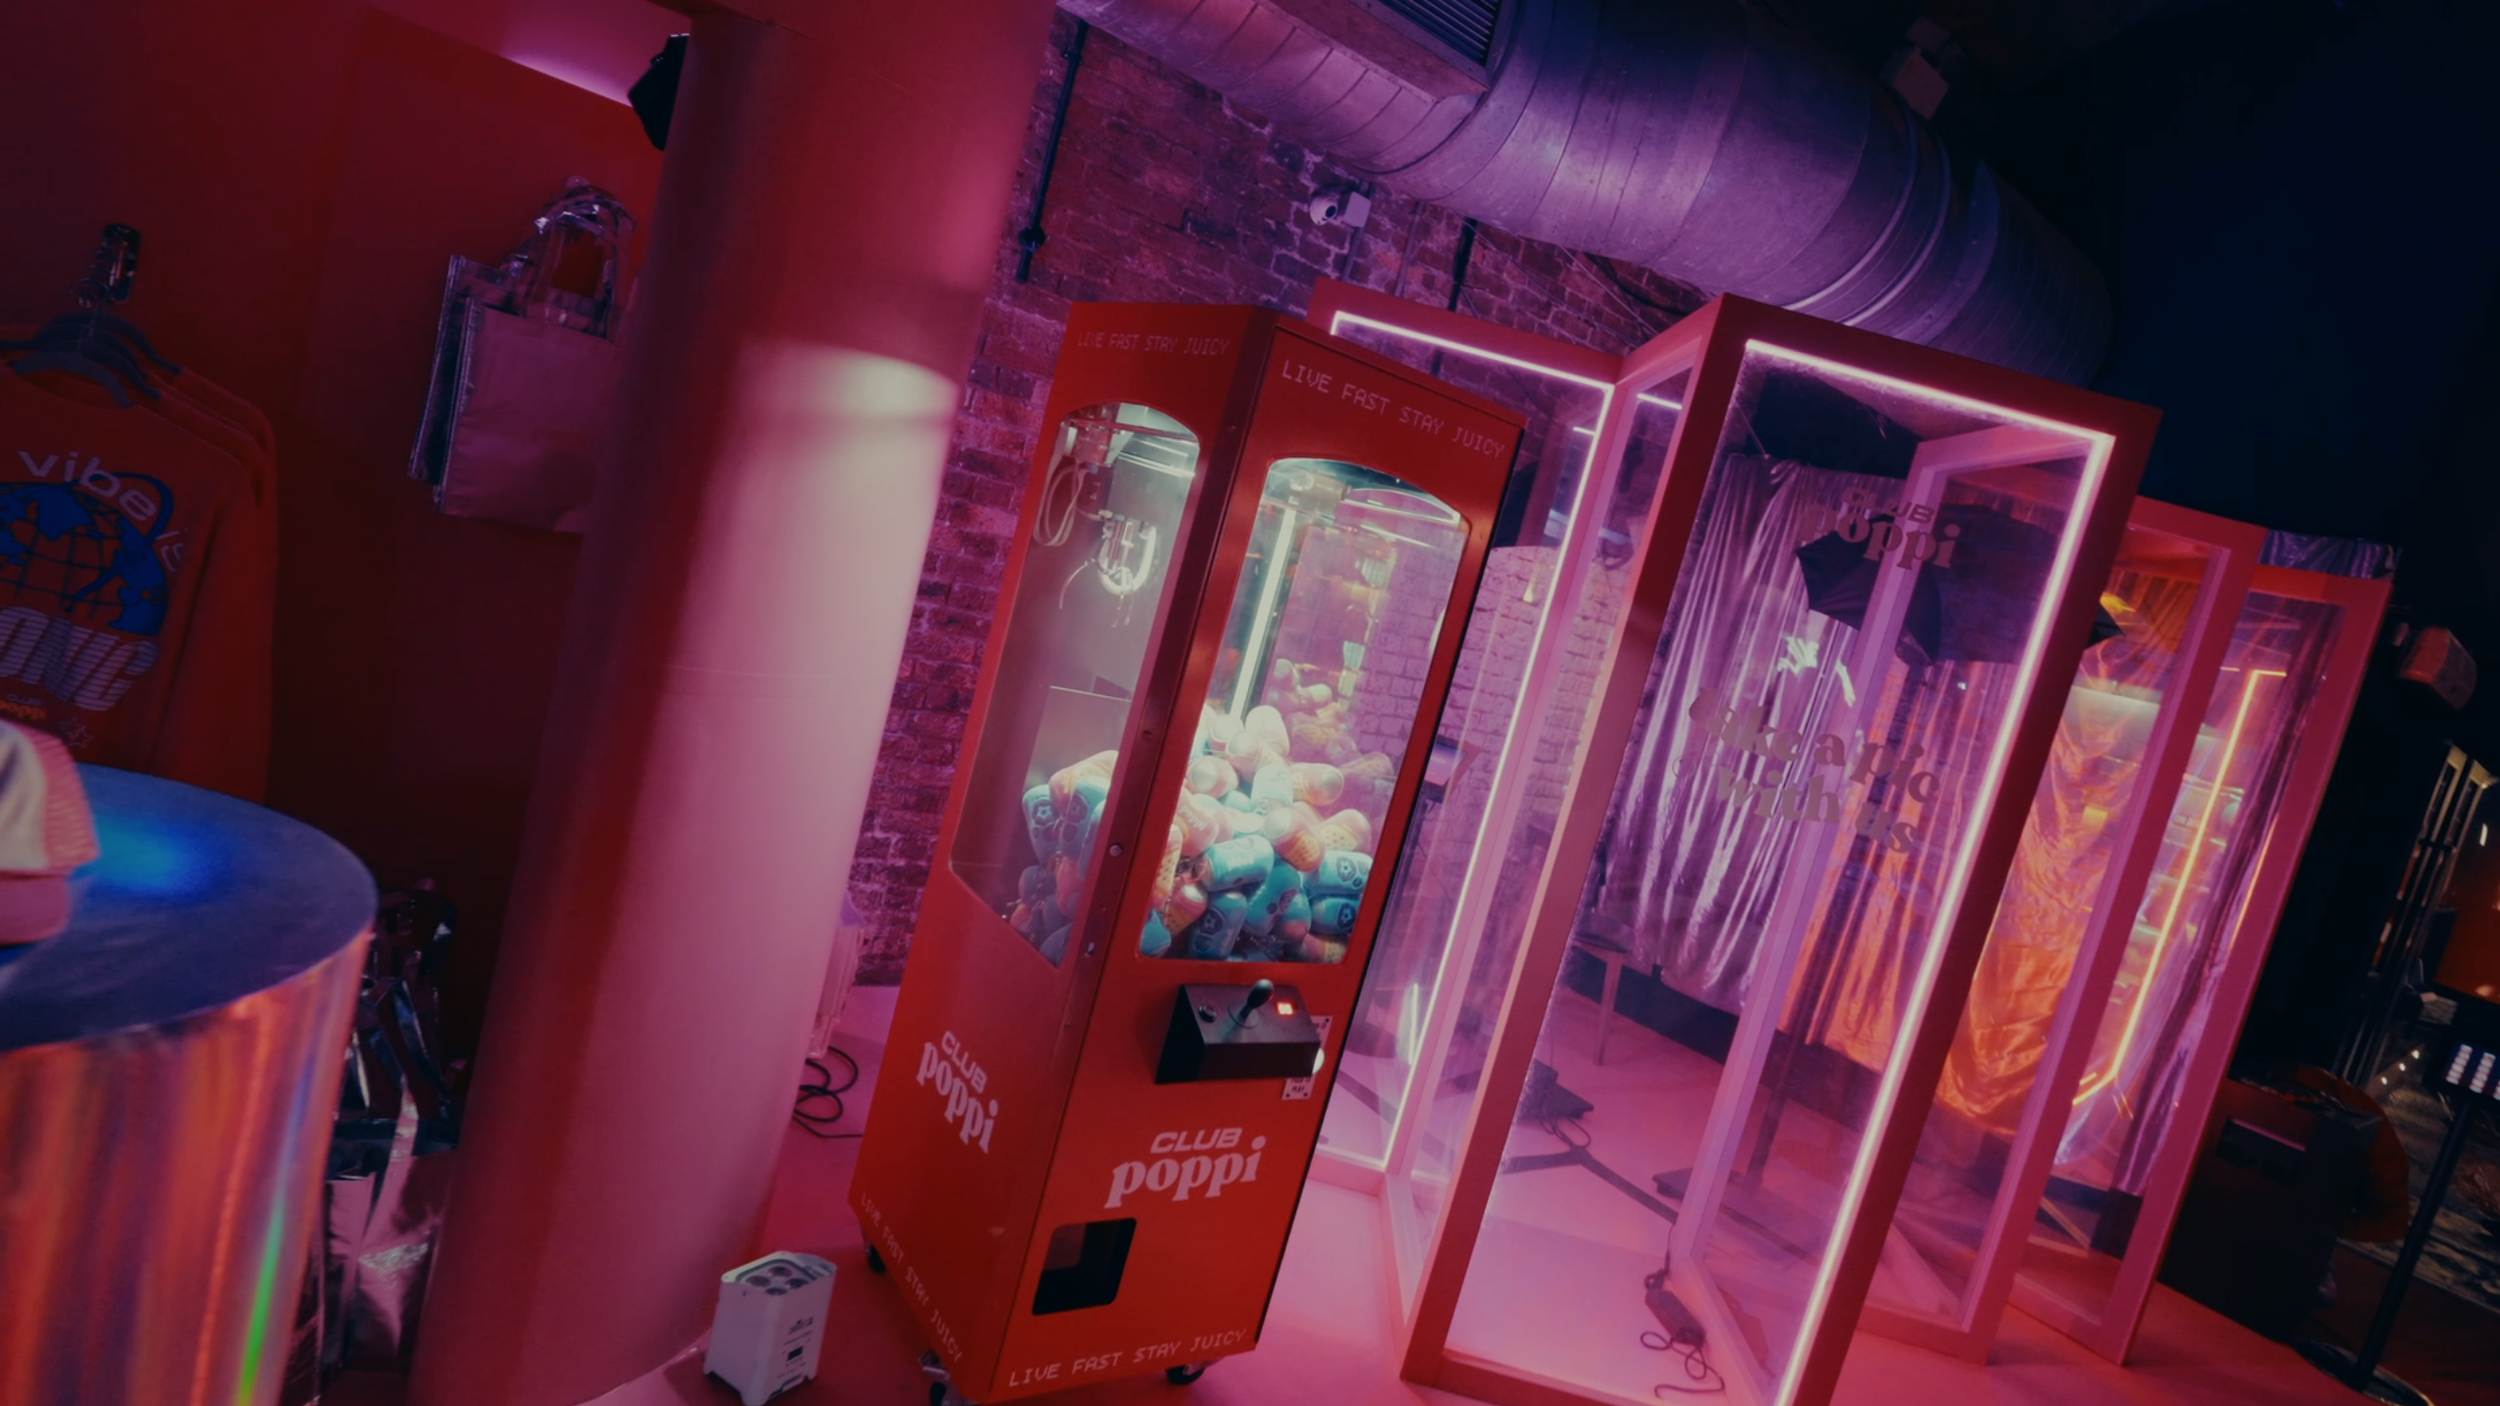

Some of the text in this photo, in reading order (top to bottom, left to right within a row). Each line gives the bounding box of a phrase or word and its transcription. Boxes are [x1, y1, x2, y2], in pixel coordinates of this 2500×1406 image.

[1077, 332, 1229, 356] LIVE FAST STAY JUICY
[1281, 360, 1505, 459] LIVE FAST STAY JUICY
[19, 450, 157, 521] vibe
[1799, 503, 1962, 570] poppi
[1814, 733, 1846, 767] a
[1850, 742, 1940, 803] pic
[1717, 765, 1919, 854] with us
[941, 1031, 988, 1093] CLUB
[916, 1042, 999, 1154] poppi
[1104, 1136, 1266, 1208] poppi
[1150, 1127, 1243, 1153] CLUB
[861, 1192, 963, 1363] LIVE FAST STAY JUICY
[1009, 1328, 1246, 1387] LIVE FAST STAY JUICY
